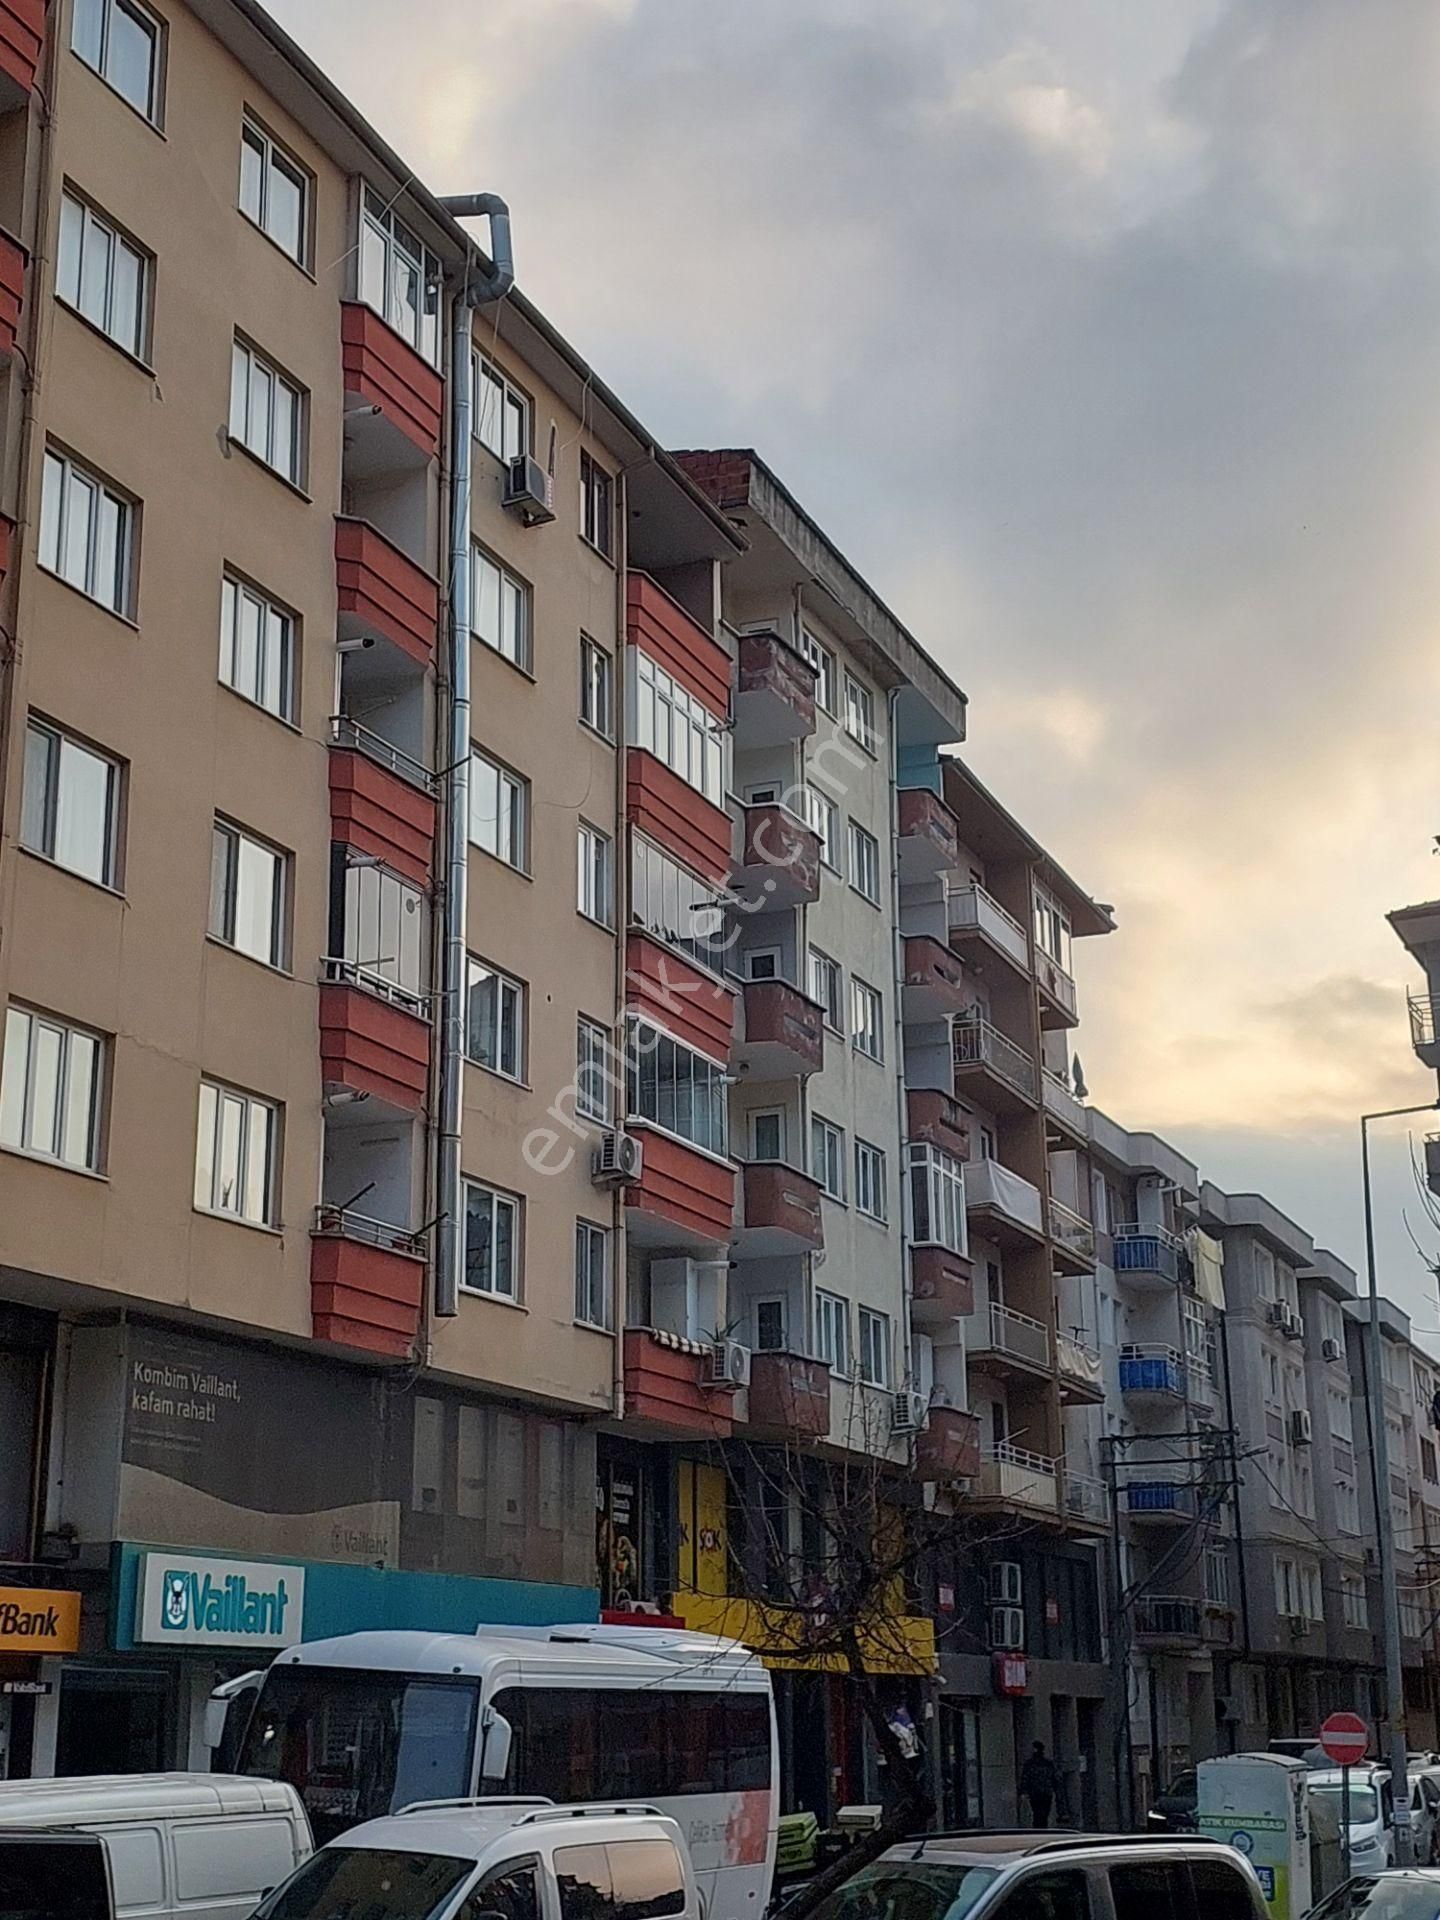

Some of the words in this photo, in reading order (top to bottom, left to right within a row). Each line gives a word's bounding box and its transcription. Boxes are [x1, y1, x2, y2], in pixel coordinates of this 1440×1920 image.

[133, 1361, 189, 1390] Kombim
[191, 1373, 241, 1403] Vaillant,
[131, 1388, 174, 1416] kafam
[177, 1399, 216, 1423] rahat!
[190, 1571, 289, 1635] Vaillant
